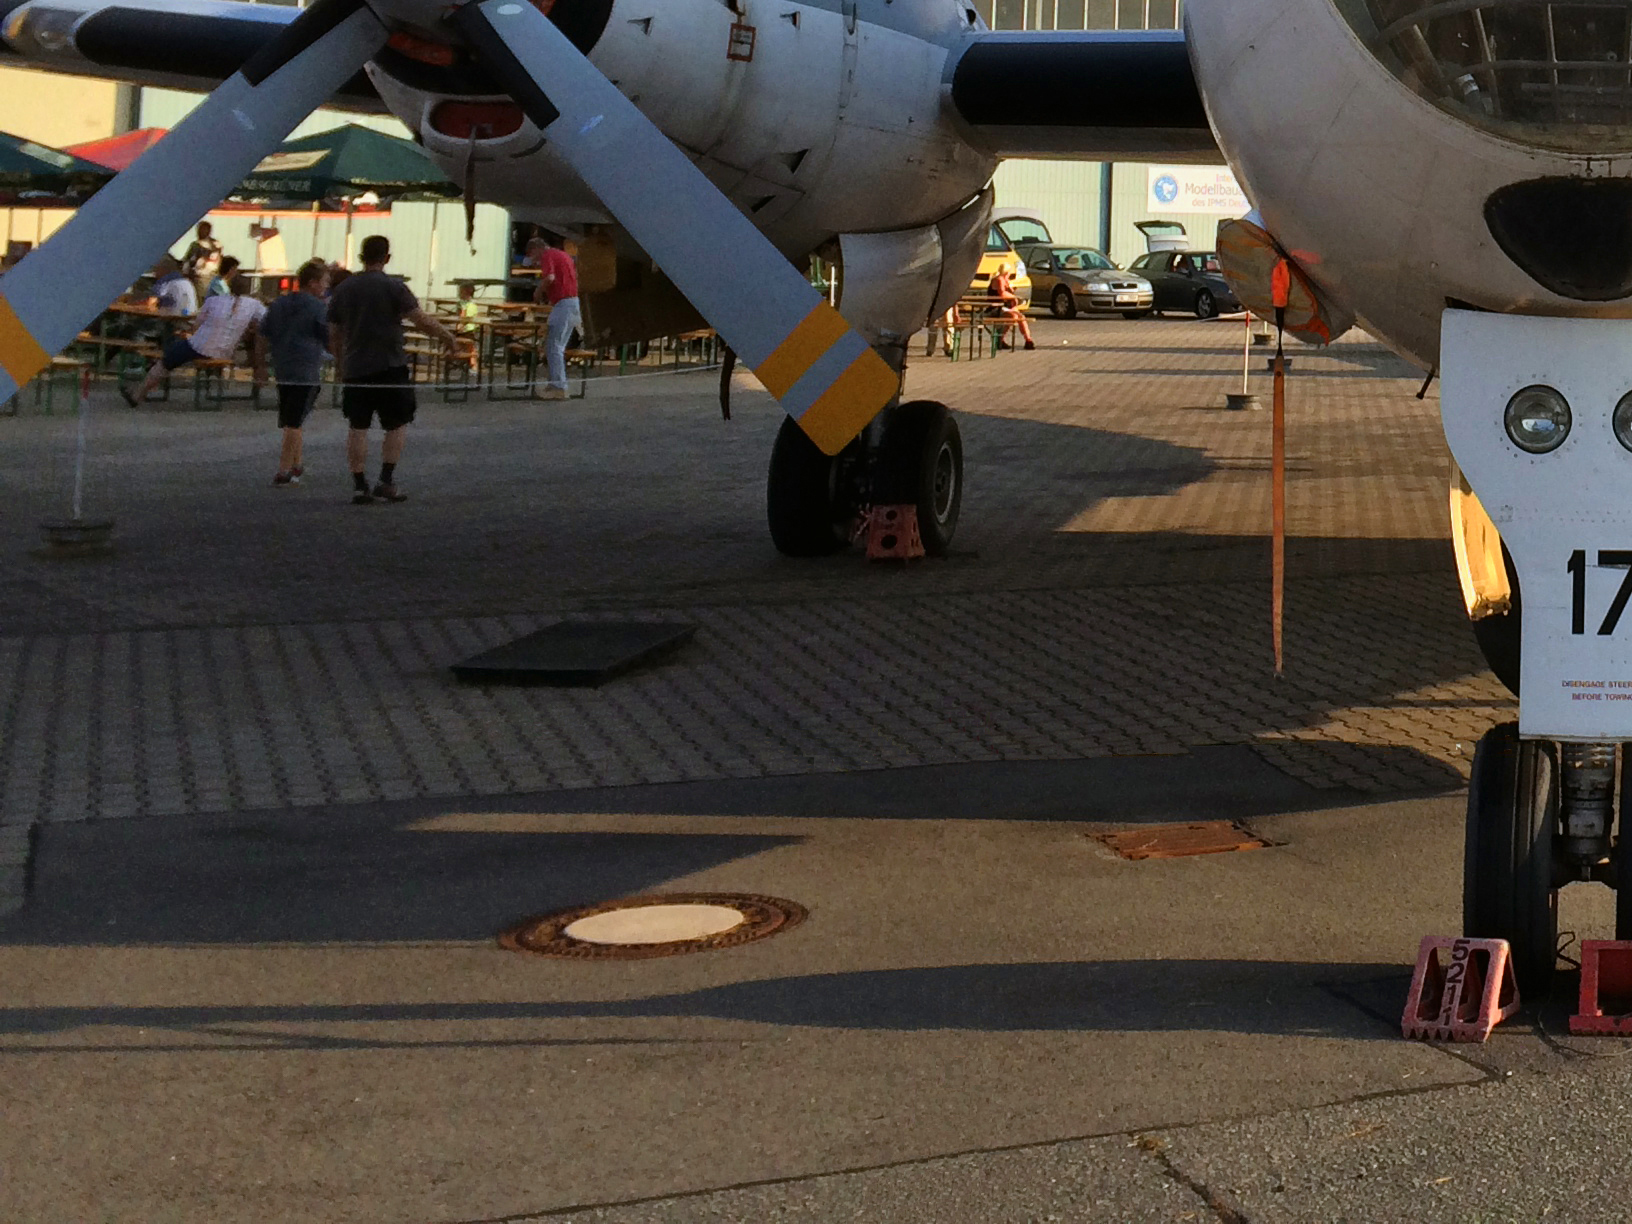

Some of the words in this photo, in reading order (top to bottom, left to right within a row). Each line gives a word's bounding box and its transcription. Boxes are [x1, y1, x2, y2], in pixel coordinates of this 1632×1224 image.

[1192, 198, 1205, 207] des
[1207, 198, 1226, 207] IPMS
[1561, 679, 1606, 689] DISENGAGE
[1571, 692, 1603, 701] BEFORE
